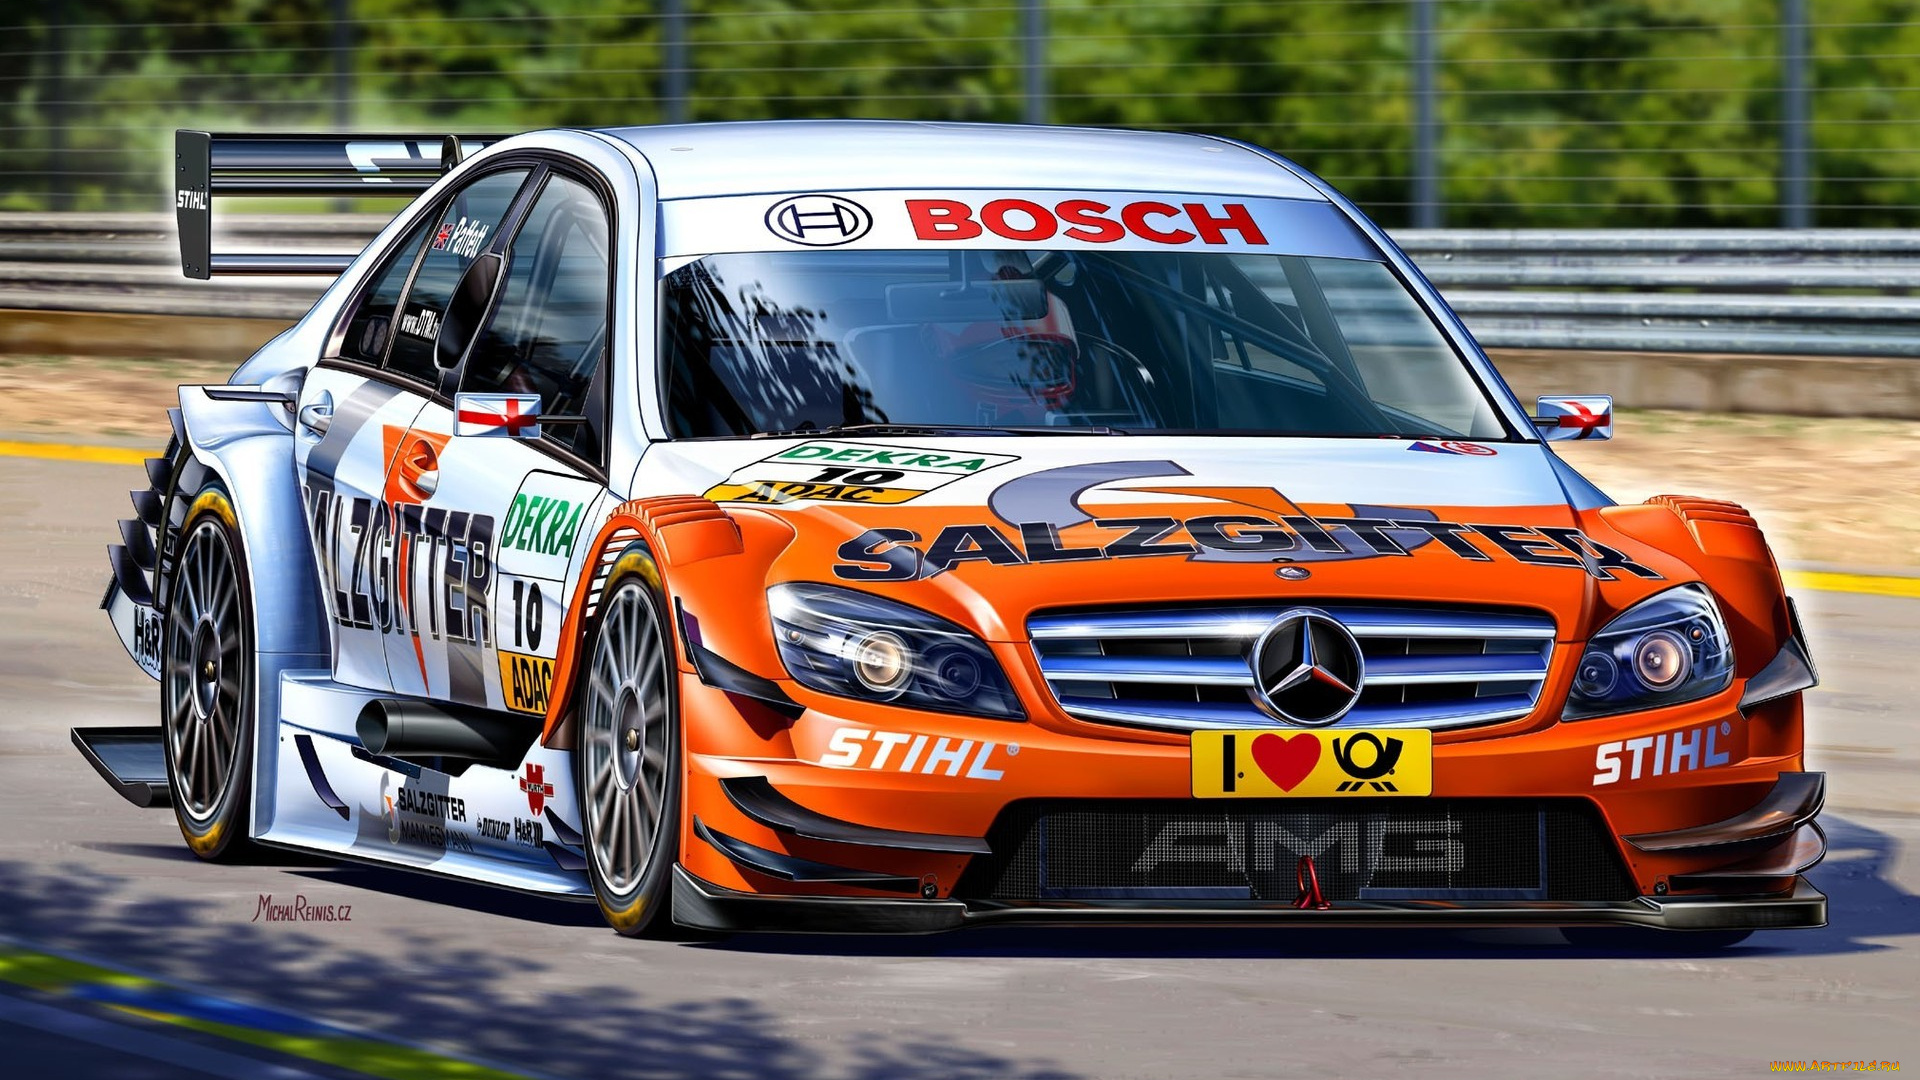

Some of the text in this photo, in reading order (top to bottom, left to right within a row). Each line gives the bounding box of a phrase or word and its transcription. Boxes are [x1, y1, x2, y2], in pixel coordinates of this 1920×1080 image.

[177, 190, 207, 209] STIHL
[904, 199, 1269, 245] BOSCH
[779, 444, 986, 471] DEKRA
[806, 467, 905, 485] 10
[742, 482, 885, 502] ADAC
[501, 494, 584, 557] DEKRA
[831, 515, 1665, 583] SALZGITTER
[303, 485, 496, 649] ALZGITTER
[134, 604, 163, 662] H&R
[512, 581, 543, 651] 10
[511, 656, 551, 712] ADAC
[820, 728, 1005, 781] STIHL
[1592, 725, 1730, 786] STIHL
[398, 786, 467, 822] SALZGITTER
[481, 817, 511, 841] DUNLOP
[401, 820, 474, 852] MANNESMANN
[1131, 820, 1464, 873] AMG
